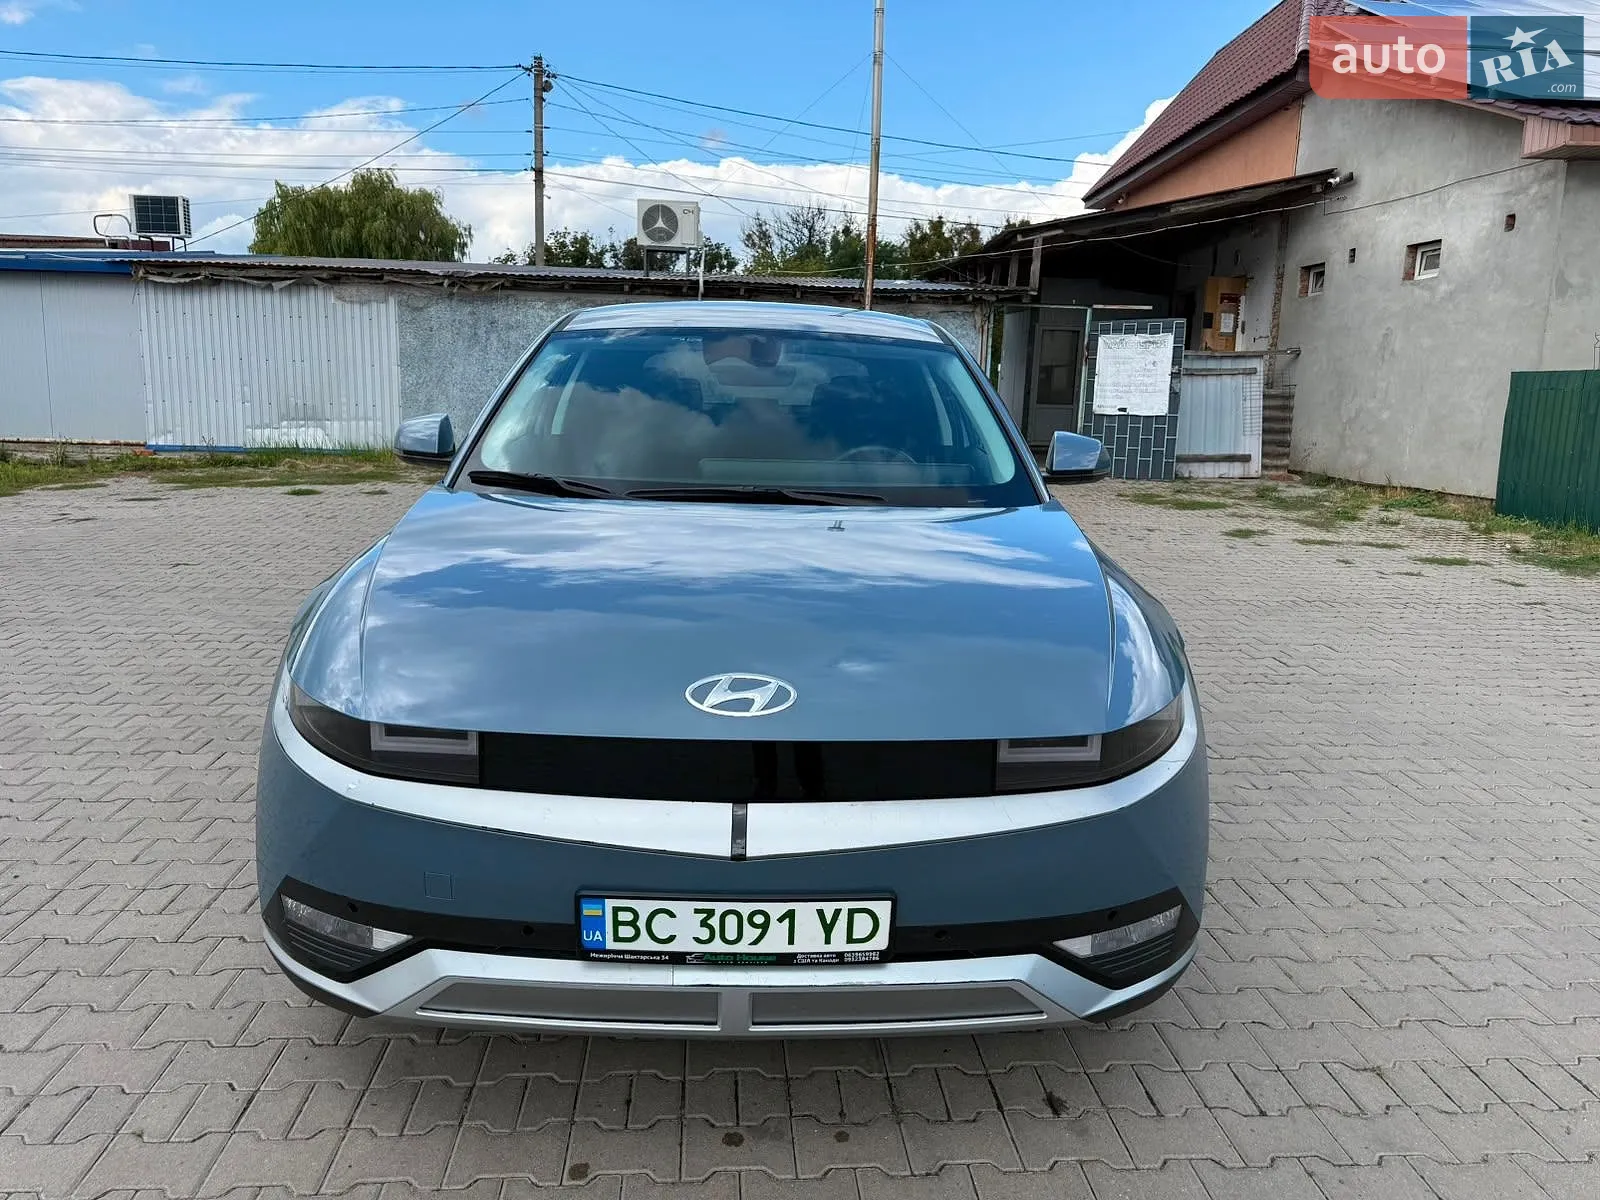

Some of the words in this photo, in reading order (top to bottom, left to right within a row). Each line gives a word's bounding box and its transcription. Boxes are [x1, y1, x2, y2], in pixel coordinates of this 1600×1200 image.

[583, 930, 603, 942] UA
[612, 906, 677, 945] BC
[692, 908, 796, 946] 3091
[815, 907, 880, 945] YD
